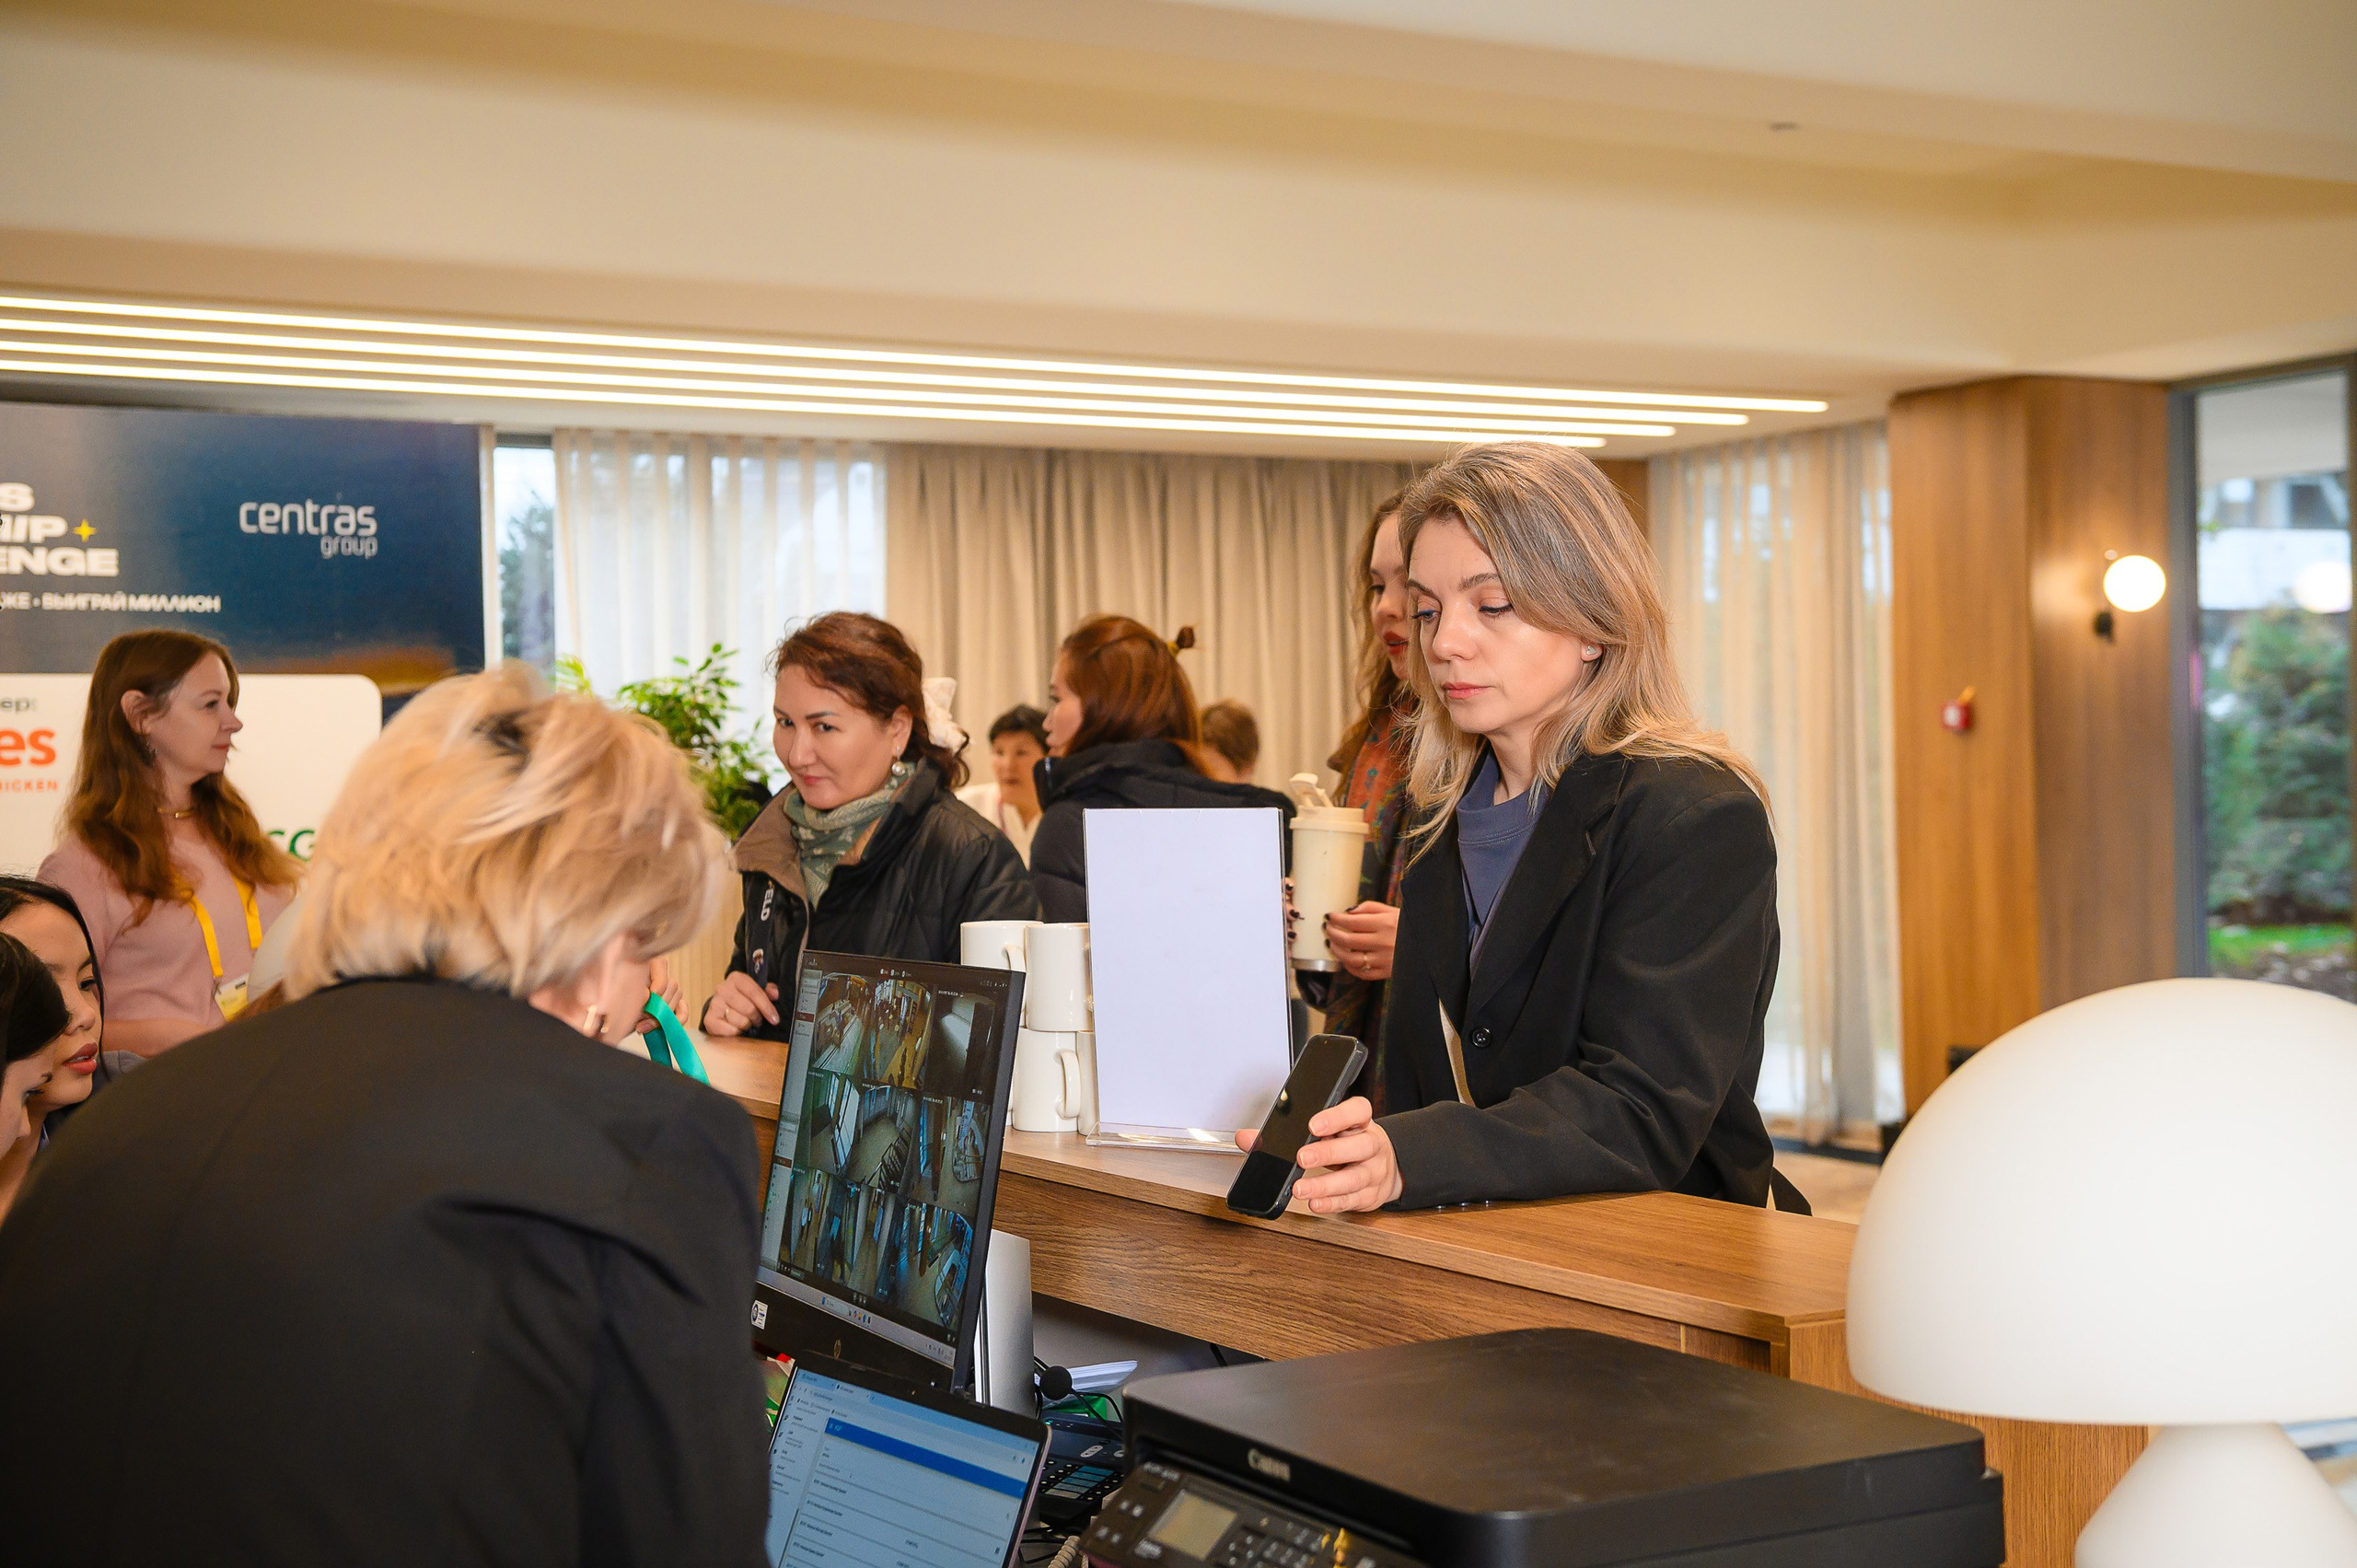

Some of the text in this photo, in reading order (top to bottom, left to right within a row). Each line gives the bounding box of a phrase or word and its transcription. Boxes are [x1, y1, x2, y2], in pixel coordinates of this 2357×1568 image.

[238, 498, 377, 537] centras
[320, 535, 378, 560] group
[0, 545, 119, 577] NGE
[41, 591, 127, 611] ВЫИГРАЙ
[128, 593, 221, 613] МИЛЛИОН
[0, 779, 58, 792] ICKEN
